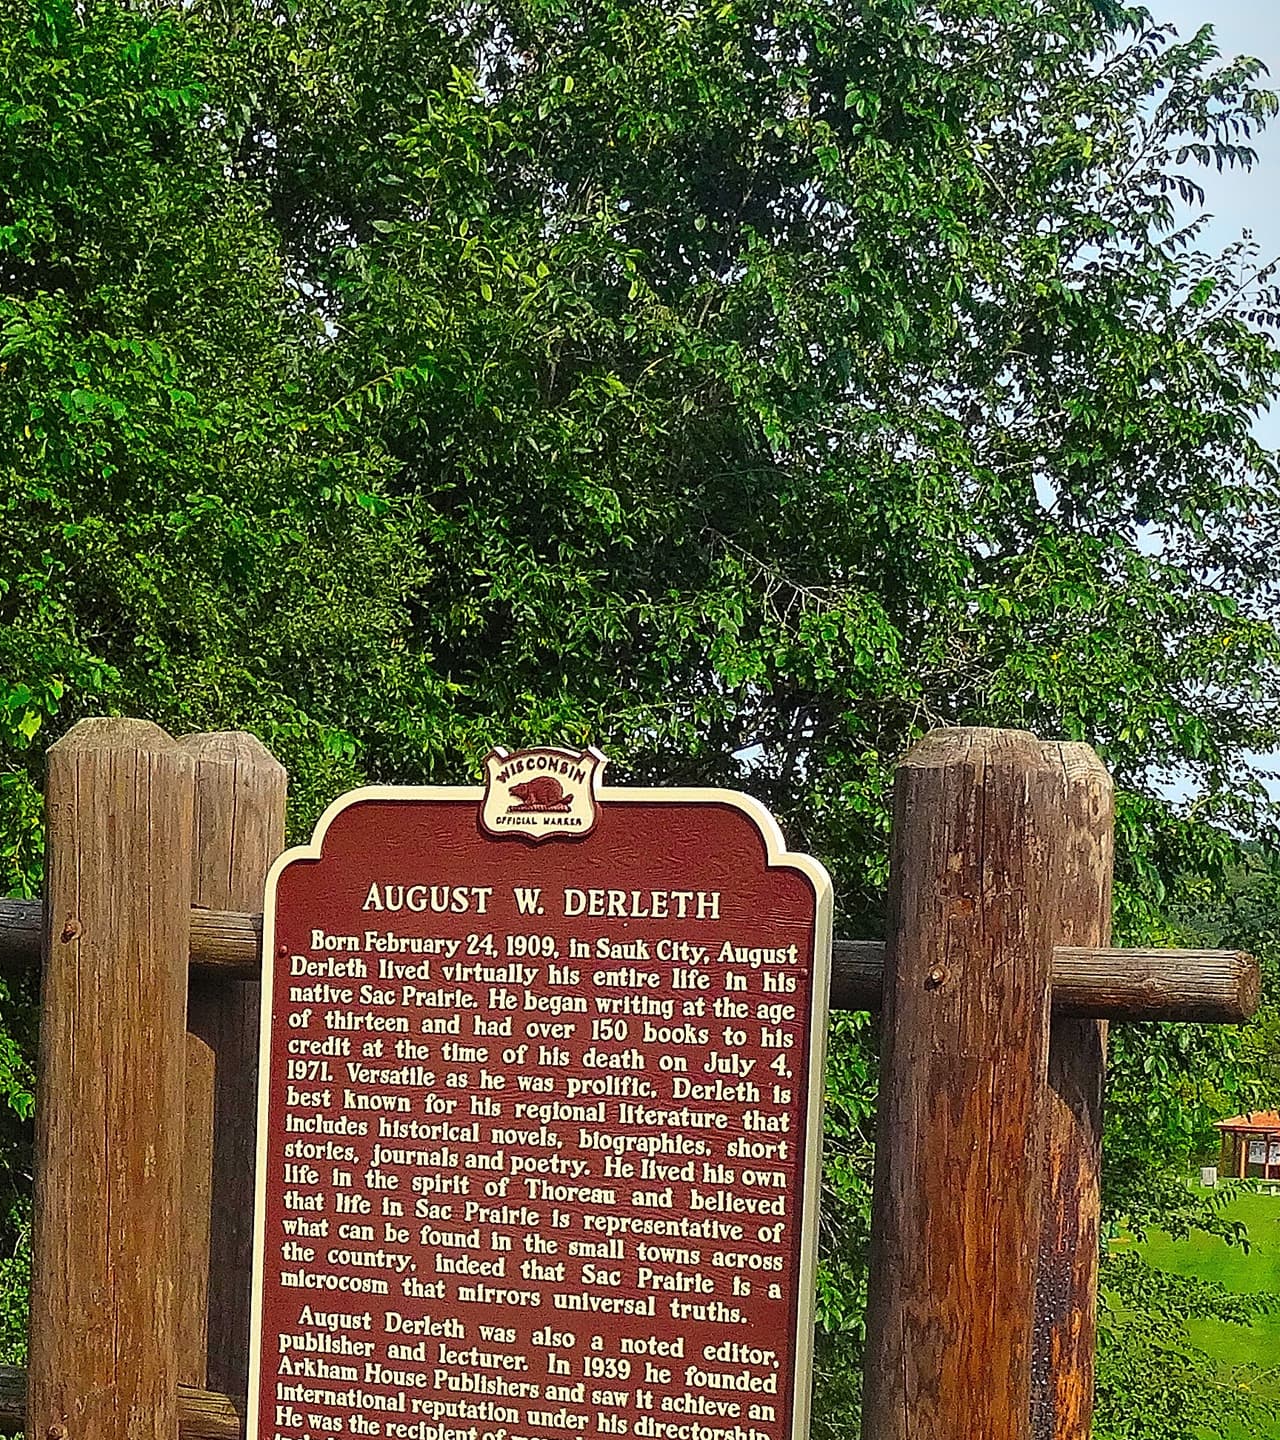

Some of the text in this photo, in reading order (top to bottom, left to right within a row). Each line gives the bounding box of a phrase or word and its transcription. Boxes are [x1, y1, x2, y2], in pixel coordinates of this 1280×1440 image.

[496, 757, 586, 784] WISCONSIN
[496, 816, 582, 826] OFFICIAL MARKER
[361, 882, 720, 919] AUGUST W. DERLETH
[310, 928, 798, 968] Born February 24, 1909, in Sauk City, August
[289, 955, 796, 992] Derleth lived virtually his entire life in his
[289, 983, 795, 1024] native Sac Prairie. He began writing at the age
[288, 1008, 793, 1048] of thirteen and had over 150 books to his
[287, 1035, 792, 1079] credit at the time of his death on July 4,
[286, 1059, 791, 1104] 1971. Versatile as he was prolific, Derleth is
[285, 1085, 790, 1137] best known for his regional literature that
[285, 1113, 788, 1159] includes historical novels, biographies, short
[284, 1139, 787, 1188] stories, journals and poetry. He lived his own
[283, 1162, 785, 1216] life in the spirit of Thoreau and believed
[282, 1190, 785, 1243] that life in Sac Prairie is representative of
[280, 1241, 782, 1299] the country, indeed that Sac Prairie is a
[280, 1268, 748, 1323] microcosm that mirrors universal truths.
[297, 1304, 779, 1368] August Derleth was also a noted editor,
[278, 1331, 777, 1394] publisher and lecturer. In 1939 he founded
[276, 1381, 406, 1412] international
[410, 1398, 519, 1423] reputation
[526, 1407, 589, 1430] under
[596, 1411, 628, 1434] his
[277, 1354, 775, 1421] Arkham House Publishers and saw it achieve an
